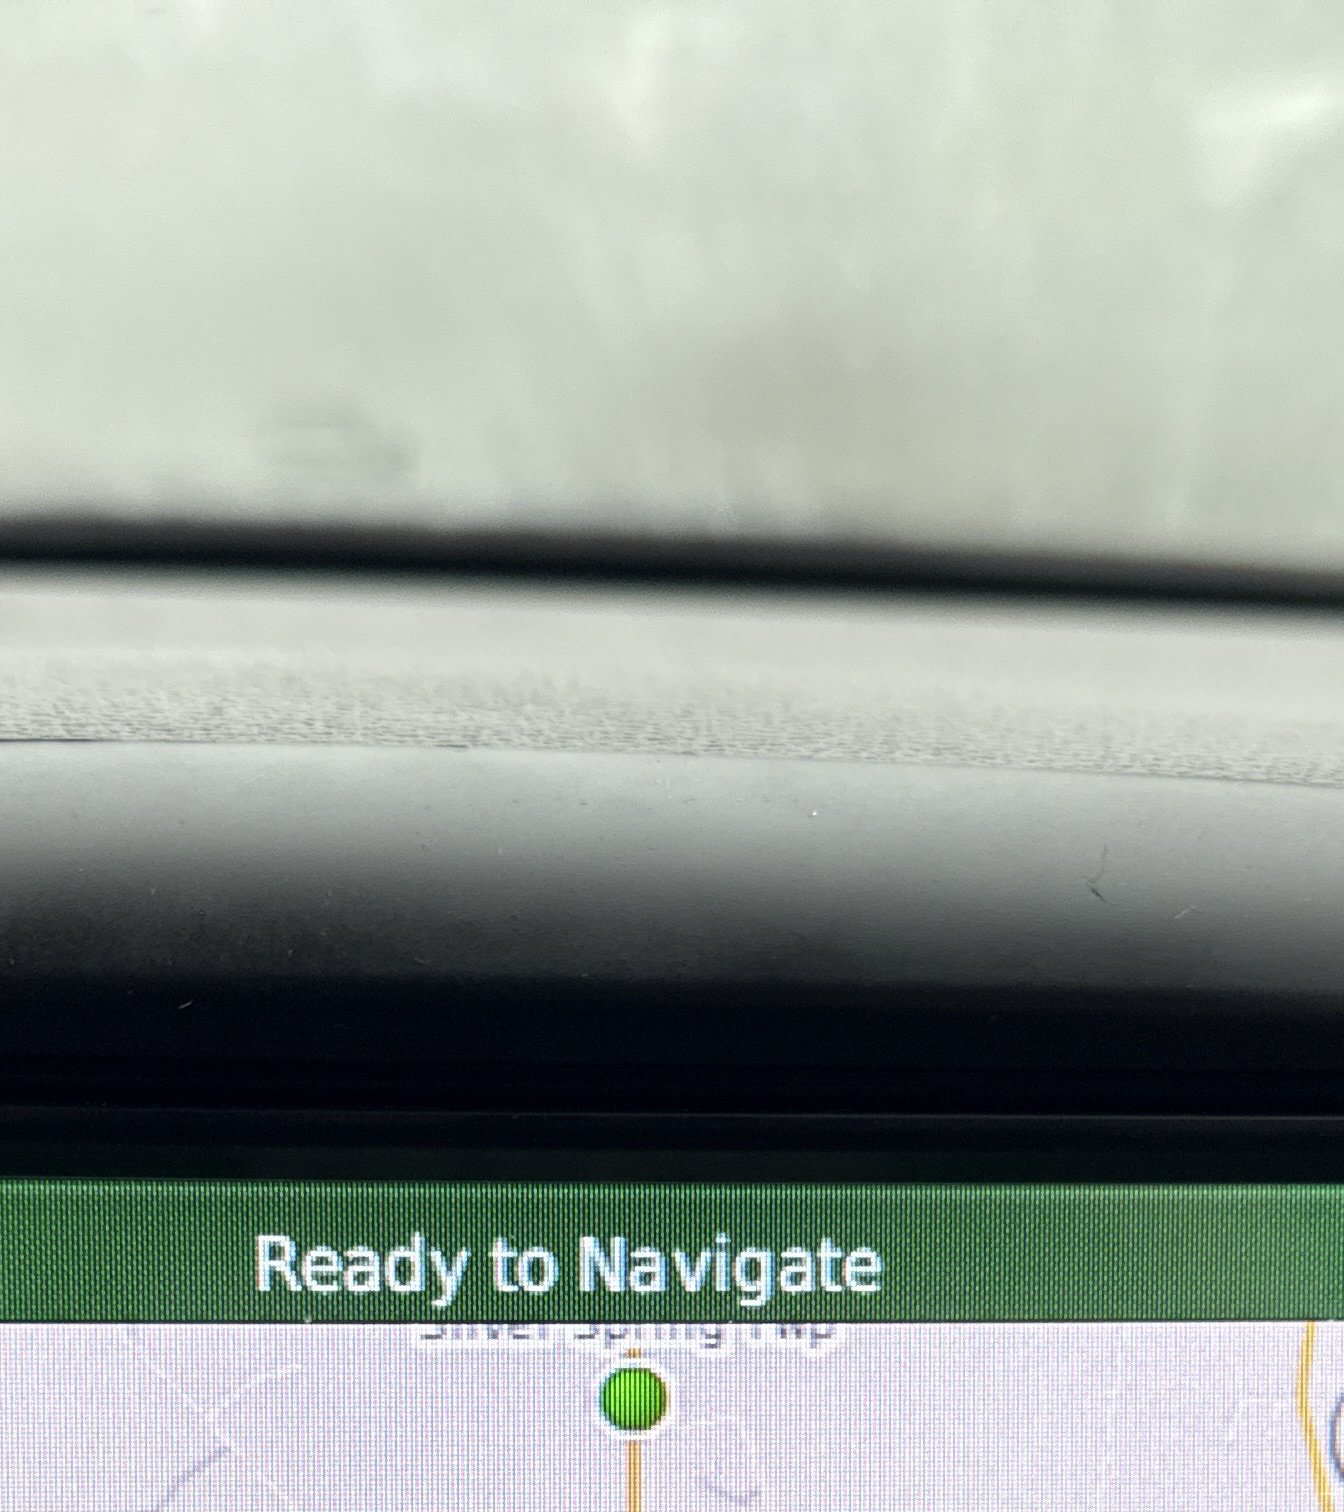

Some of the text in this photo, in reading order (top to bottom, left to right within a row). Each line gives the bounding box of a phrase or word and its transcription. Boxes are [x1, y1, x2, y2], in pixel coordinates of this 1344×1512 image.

[257, 1233, 884, 1305] Ready to Navigate
